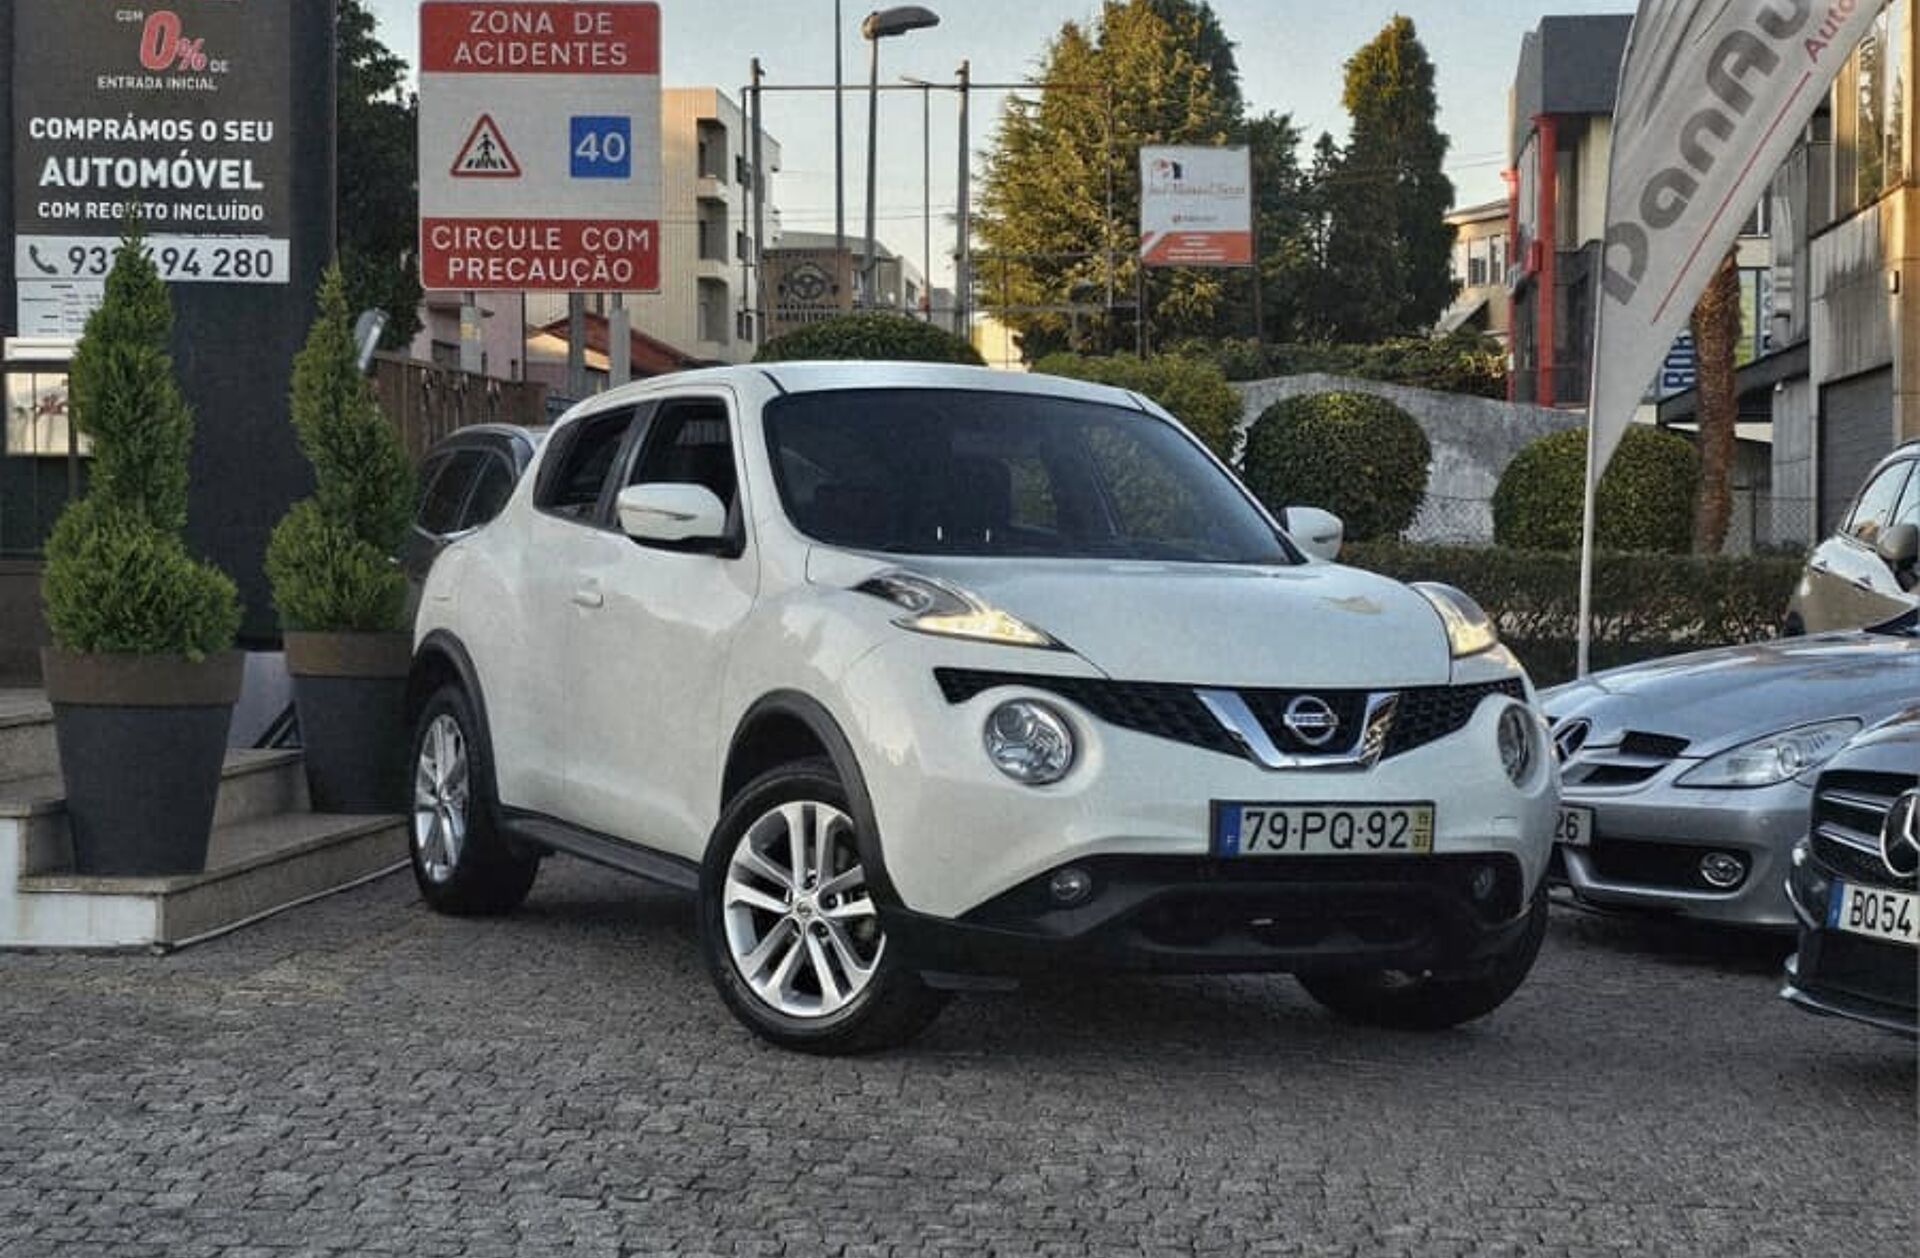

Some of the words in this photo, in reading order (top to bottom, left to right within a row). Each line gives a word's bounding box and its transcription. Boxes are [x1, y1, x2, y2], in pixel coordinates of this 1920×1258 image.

[470, 11, 554, 34] ZONA
[574, 12, 614, 34] DE
[139, 10, 208, 70] 0%
[210, 60, 229, 73] DE
[453, 42, 628, 66] ACIDENTES
[97, 76, 163, 90] ENTRADA
[166, 77, 218, 91] INICIAL
[29, 112, 193, 141] COMPRÁMOS
[201, 119, 217, 142] O
[223, 120, 274, 142] SEU
[575, 131, 626, 163] 40
[39, 149, 264, 190] AUTOMÓVEL
[38, 201, 80, 219] COM
[173, 199, 264, 222] INCLUÍDO
[431, 226, 562, 250] CIRCULE
[581, 227, 649, 250] COM
[212, 248, 274, 278] 280
[449, 255, 633, 286] PRECAUÇÃO
